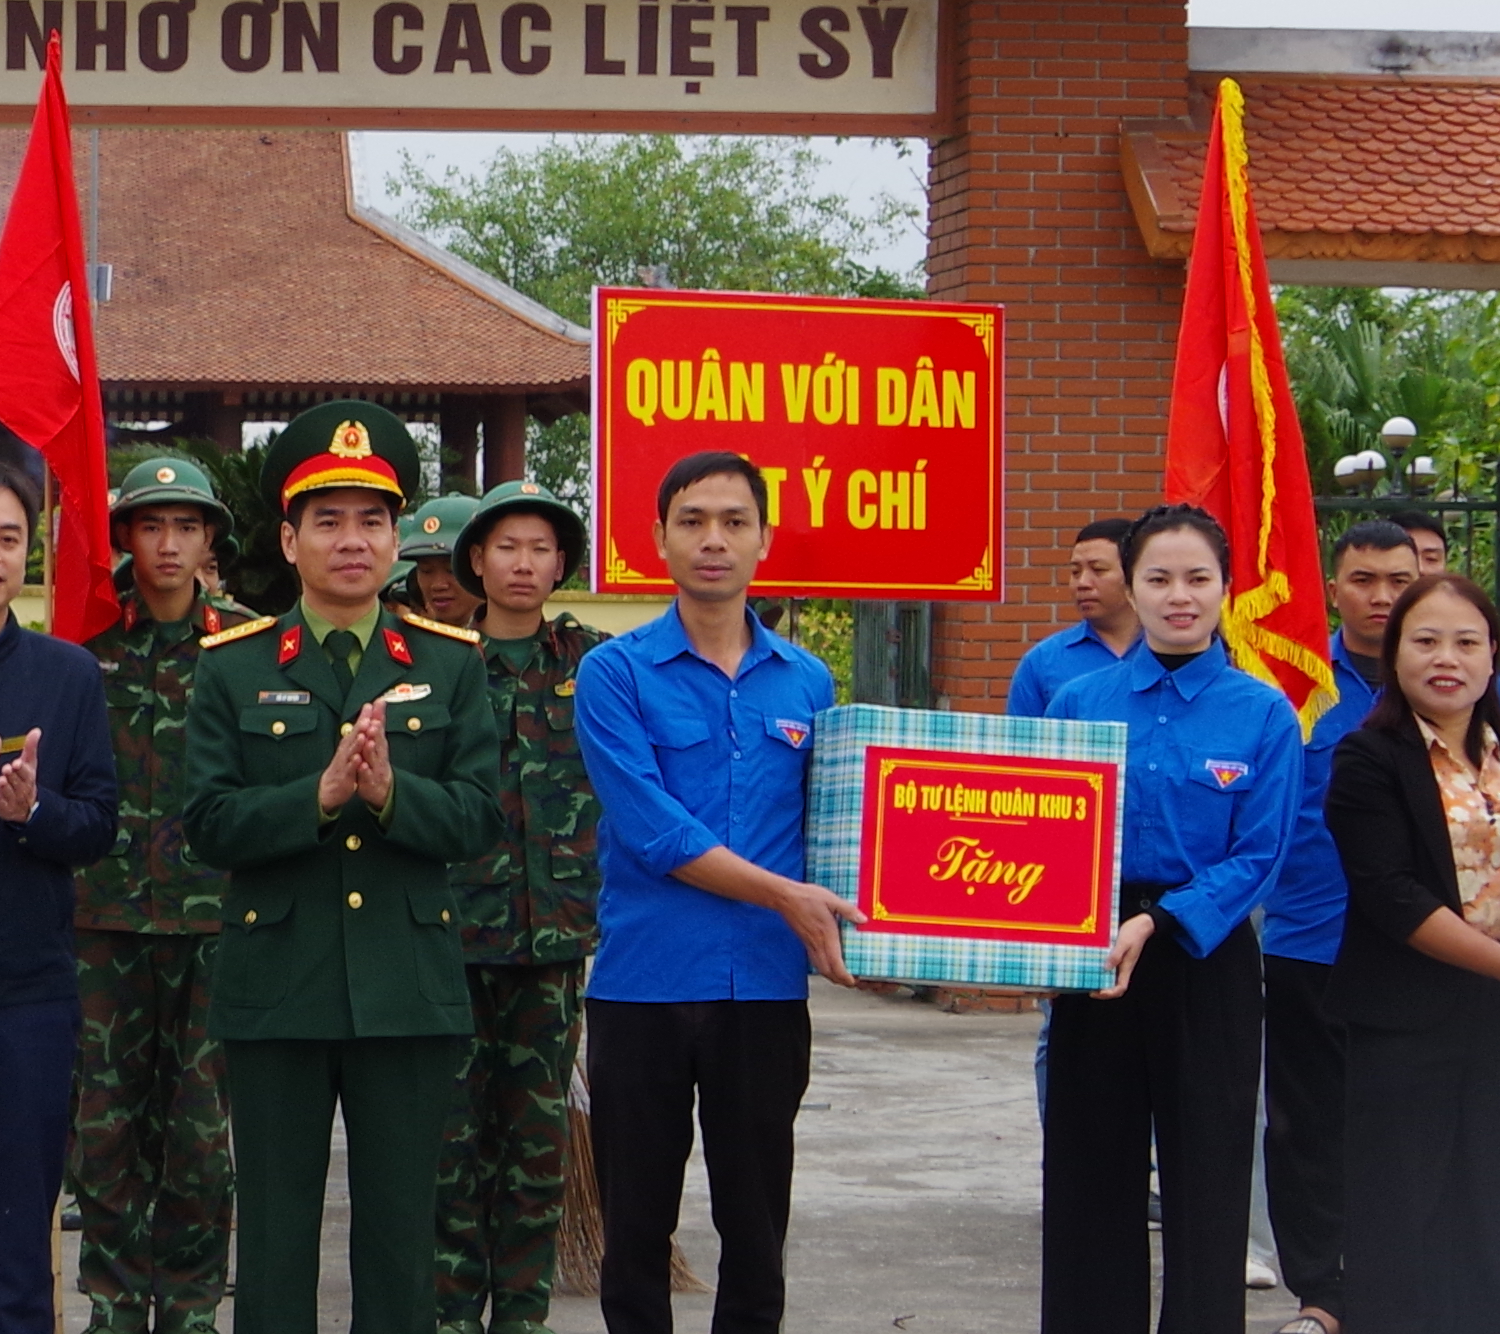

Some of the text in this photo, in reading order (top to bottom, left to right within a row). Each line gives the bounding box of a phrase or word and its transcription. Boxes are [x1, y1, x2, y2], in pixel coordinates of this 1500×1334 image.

[625, 347, 976, 429] QUÂN VỚI DÂN
[801, 455, 832, 528] Ý
[847, 459, 928, 530] CHÍ
[893, 780, 1087, 821] BỘ TƯ LỆNH QUÂN KHU 3
[929, 836, 1045, 905] Tặng
